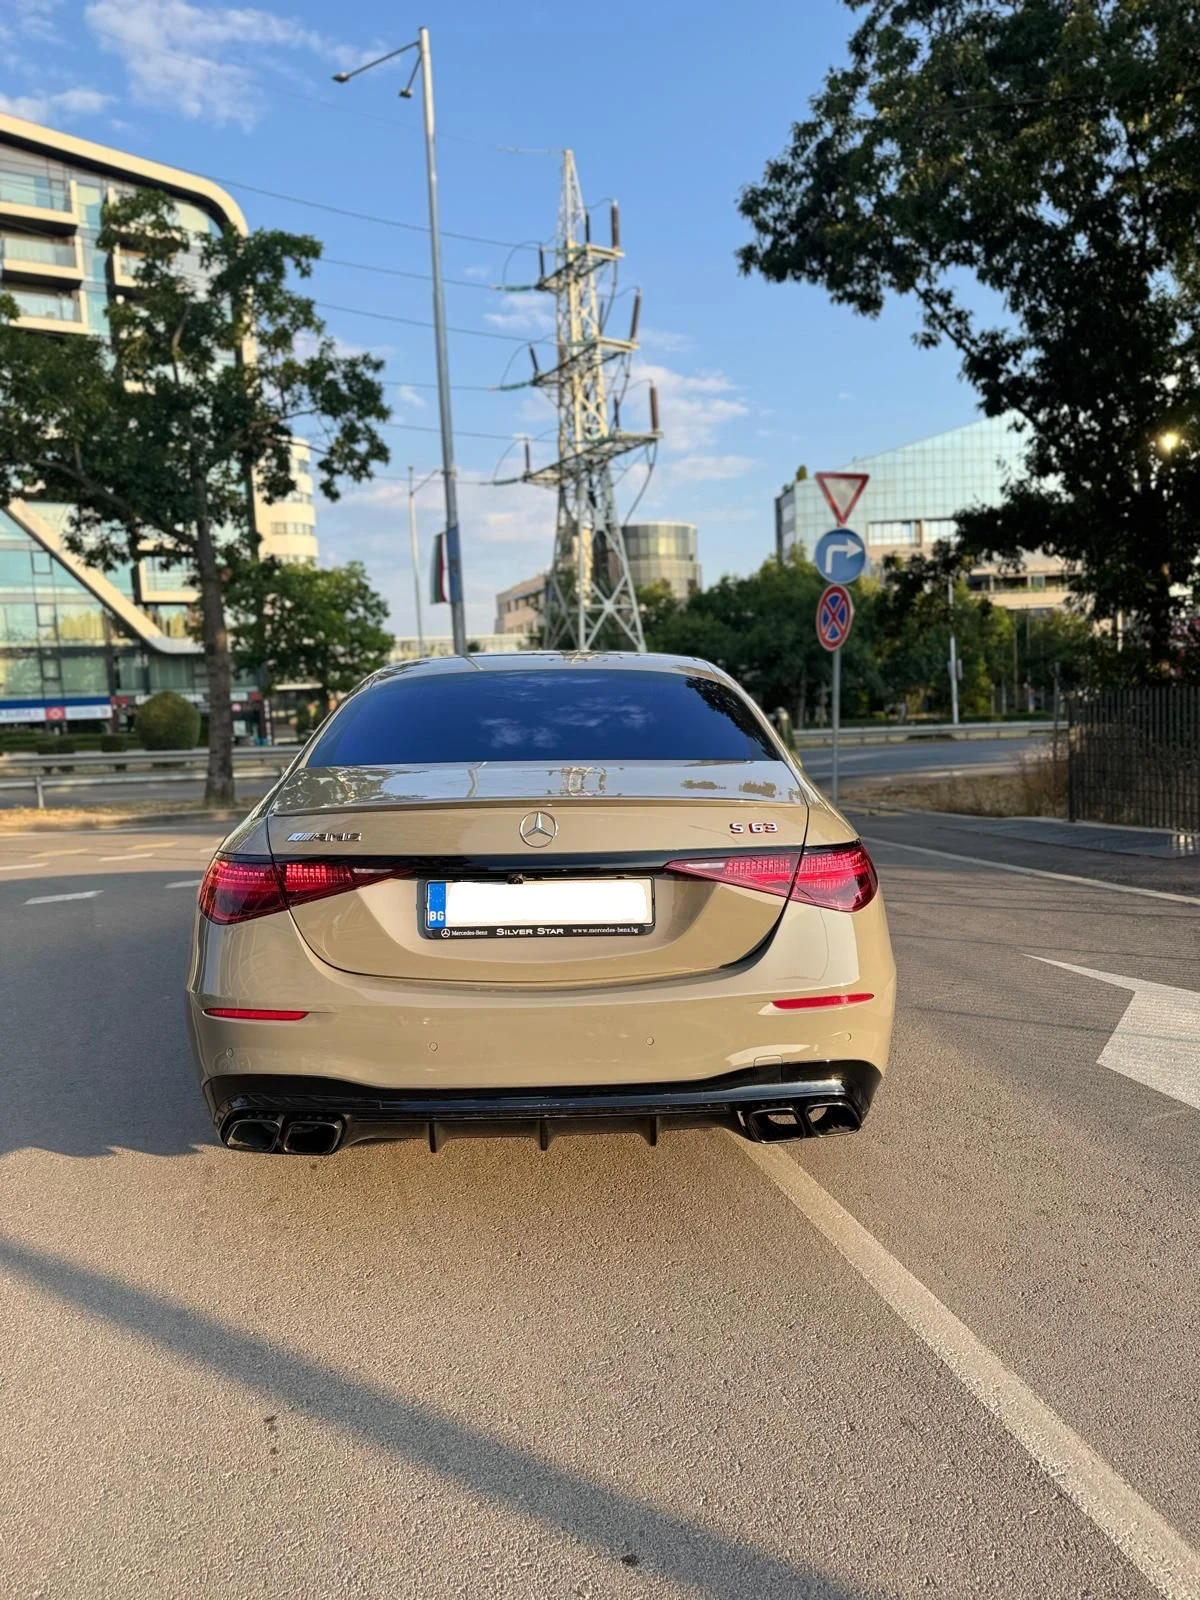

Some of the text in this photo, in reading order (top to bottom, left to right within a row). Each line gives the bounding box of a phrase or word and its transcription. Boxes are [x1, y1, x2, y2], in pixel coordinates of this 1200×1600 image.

[729, 822, 778, 834] S 63
[314, 832, 362, 842] AMG
[429, 911, 444, 921] BG
[572, 926, 639, 934] www.mercedes-benz.bg
